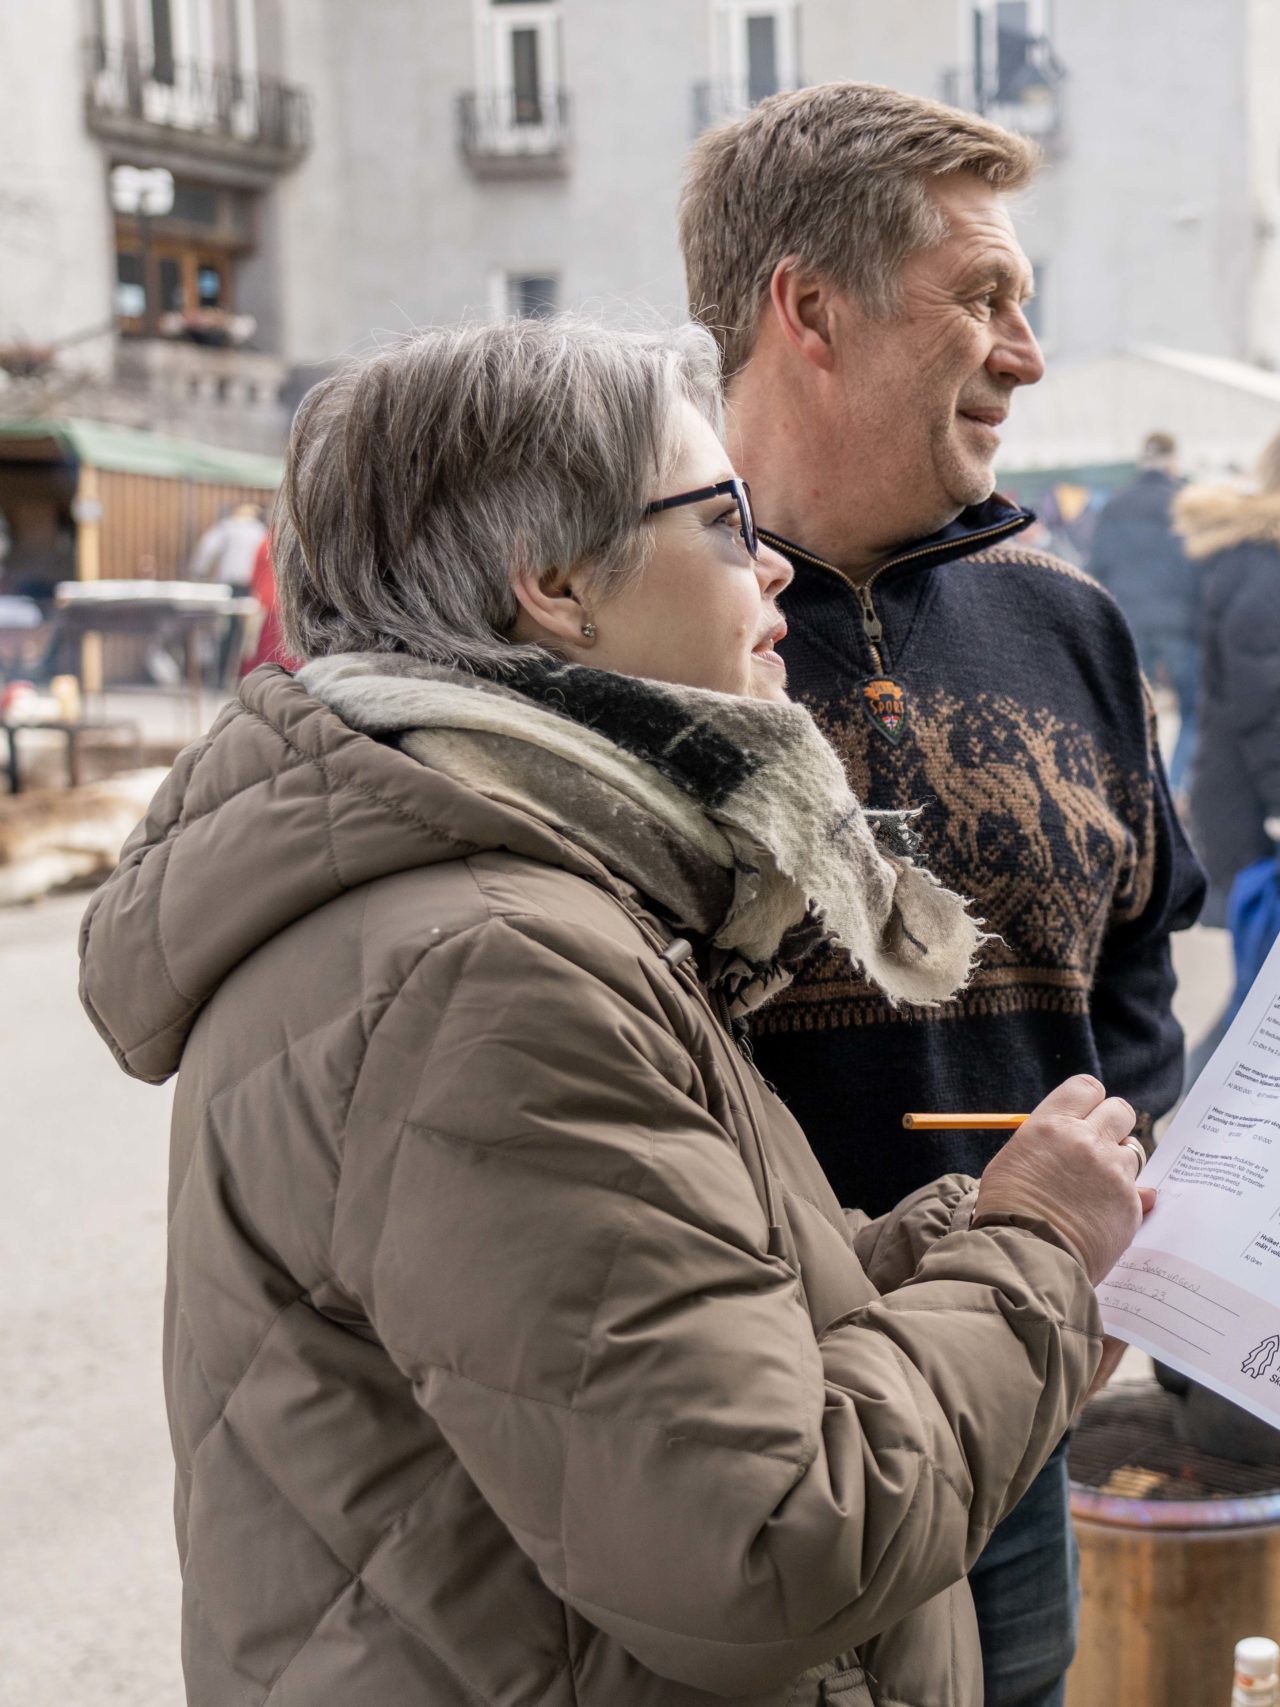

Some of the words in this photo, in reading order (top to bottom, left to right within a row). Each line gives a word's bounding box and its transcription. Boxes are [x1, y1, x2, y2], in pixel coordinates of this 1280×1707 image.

[1260, 1234, 1279, 1247] Hvilket
[1255, 1241, 1268, 1250] målt
[1250, 1257, 1262, 1266] Gran
